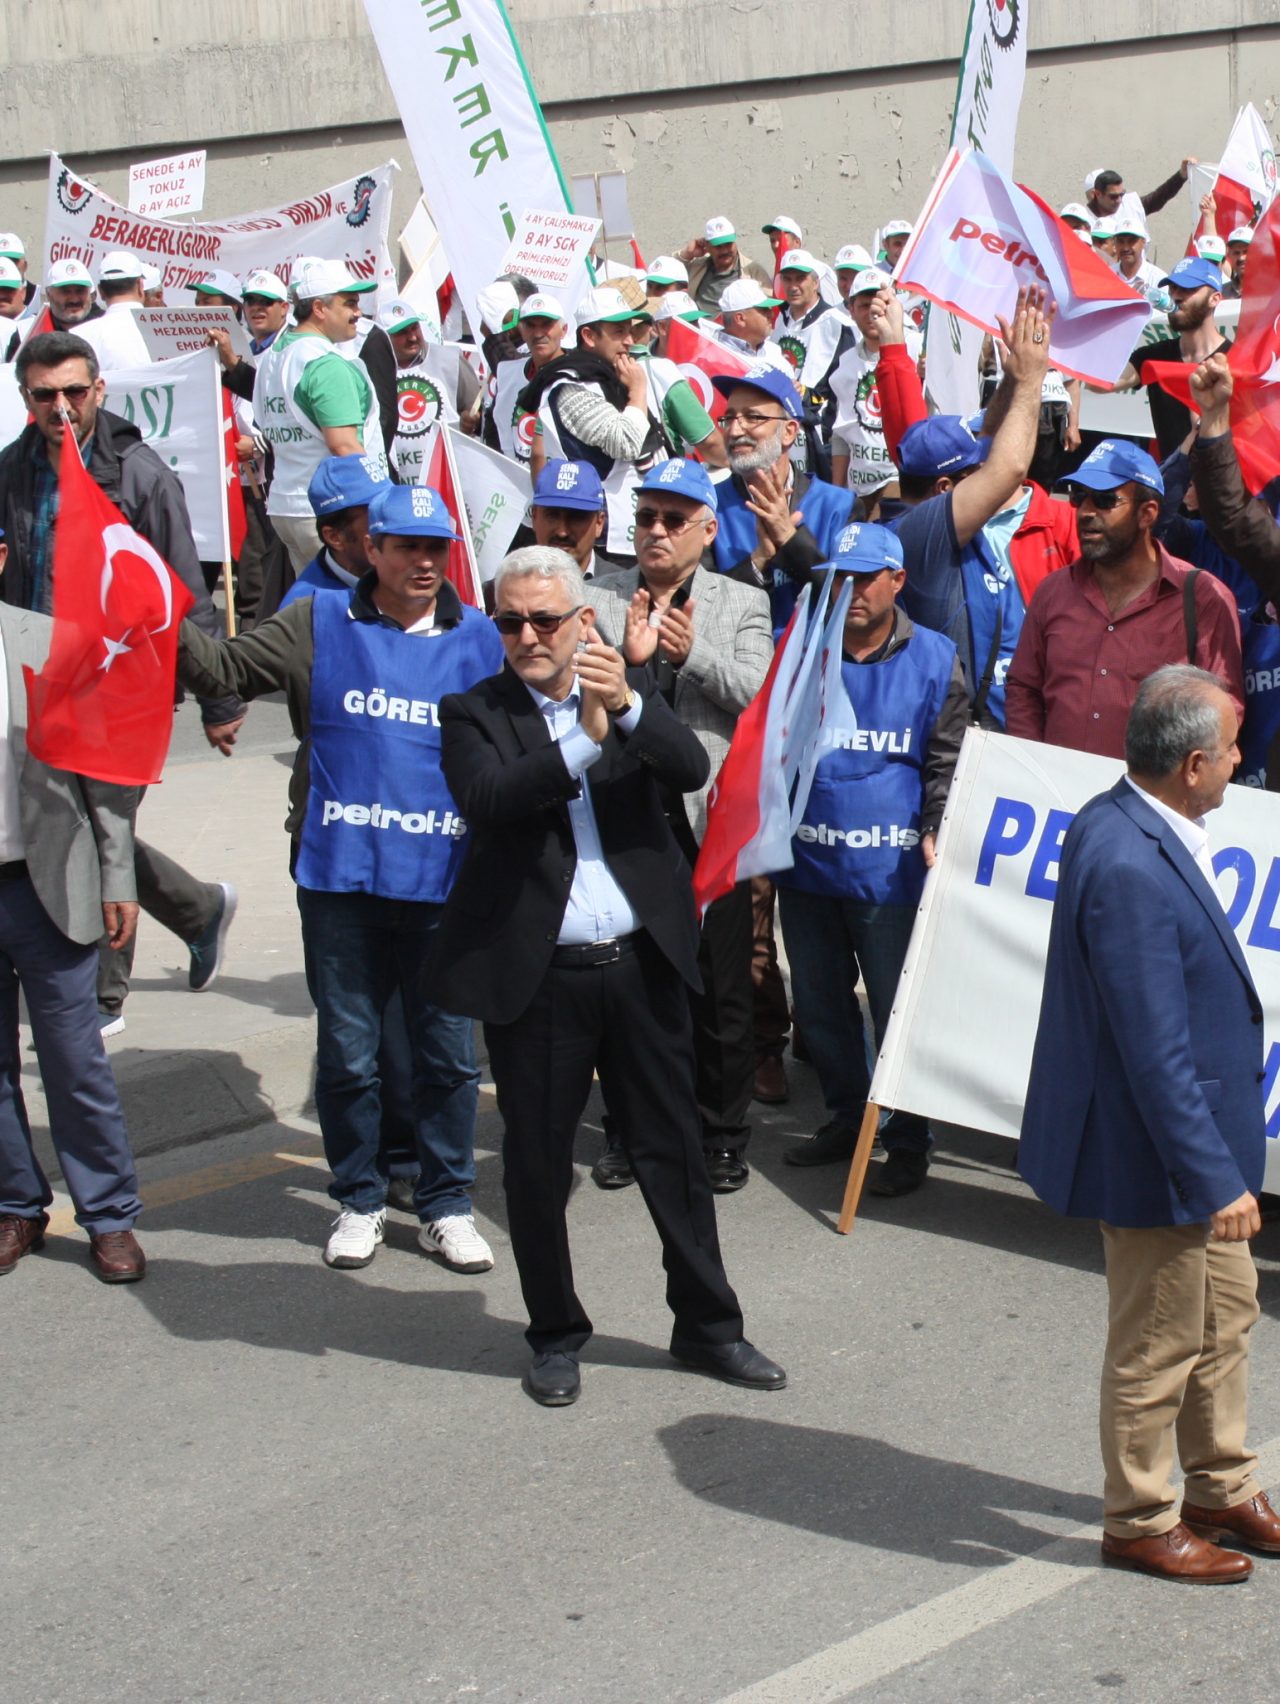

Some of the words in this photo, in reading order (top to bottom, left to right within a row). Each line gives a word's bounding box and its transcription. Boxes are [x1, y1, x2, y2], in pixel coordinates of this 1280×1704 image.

[133, 163, 174, 181] SENEDE
[178, 160, 185, 171] 4
[188, 157, 203, 169] AY
[149, 178, 185, 195] TOKUZ
[139, 203, 146, 214] 8
[149, 201, 164, 212] AY
[166, 194, 191, 208] AÇIZ
[532, 214, 544, 224] AY
[525, 231, 535, 245] 8
[535, 233, 553, 247] AY
[553, 236, 580, 252] SGK
[140, 313, 148, 323] 4
[150, 313, 164, 323] AY
[167, 312, 232, 324] ÇALIŞARAK
[153, 326, 210, 337] MEZARDA
[322, 800, 468, 841] petrol-iş
[797, 823, 921, 851] etrol-iş
